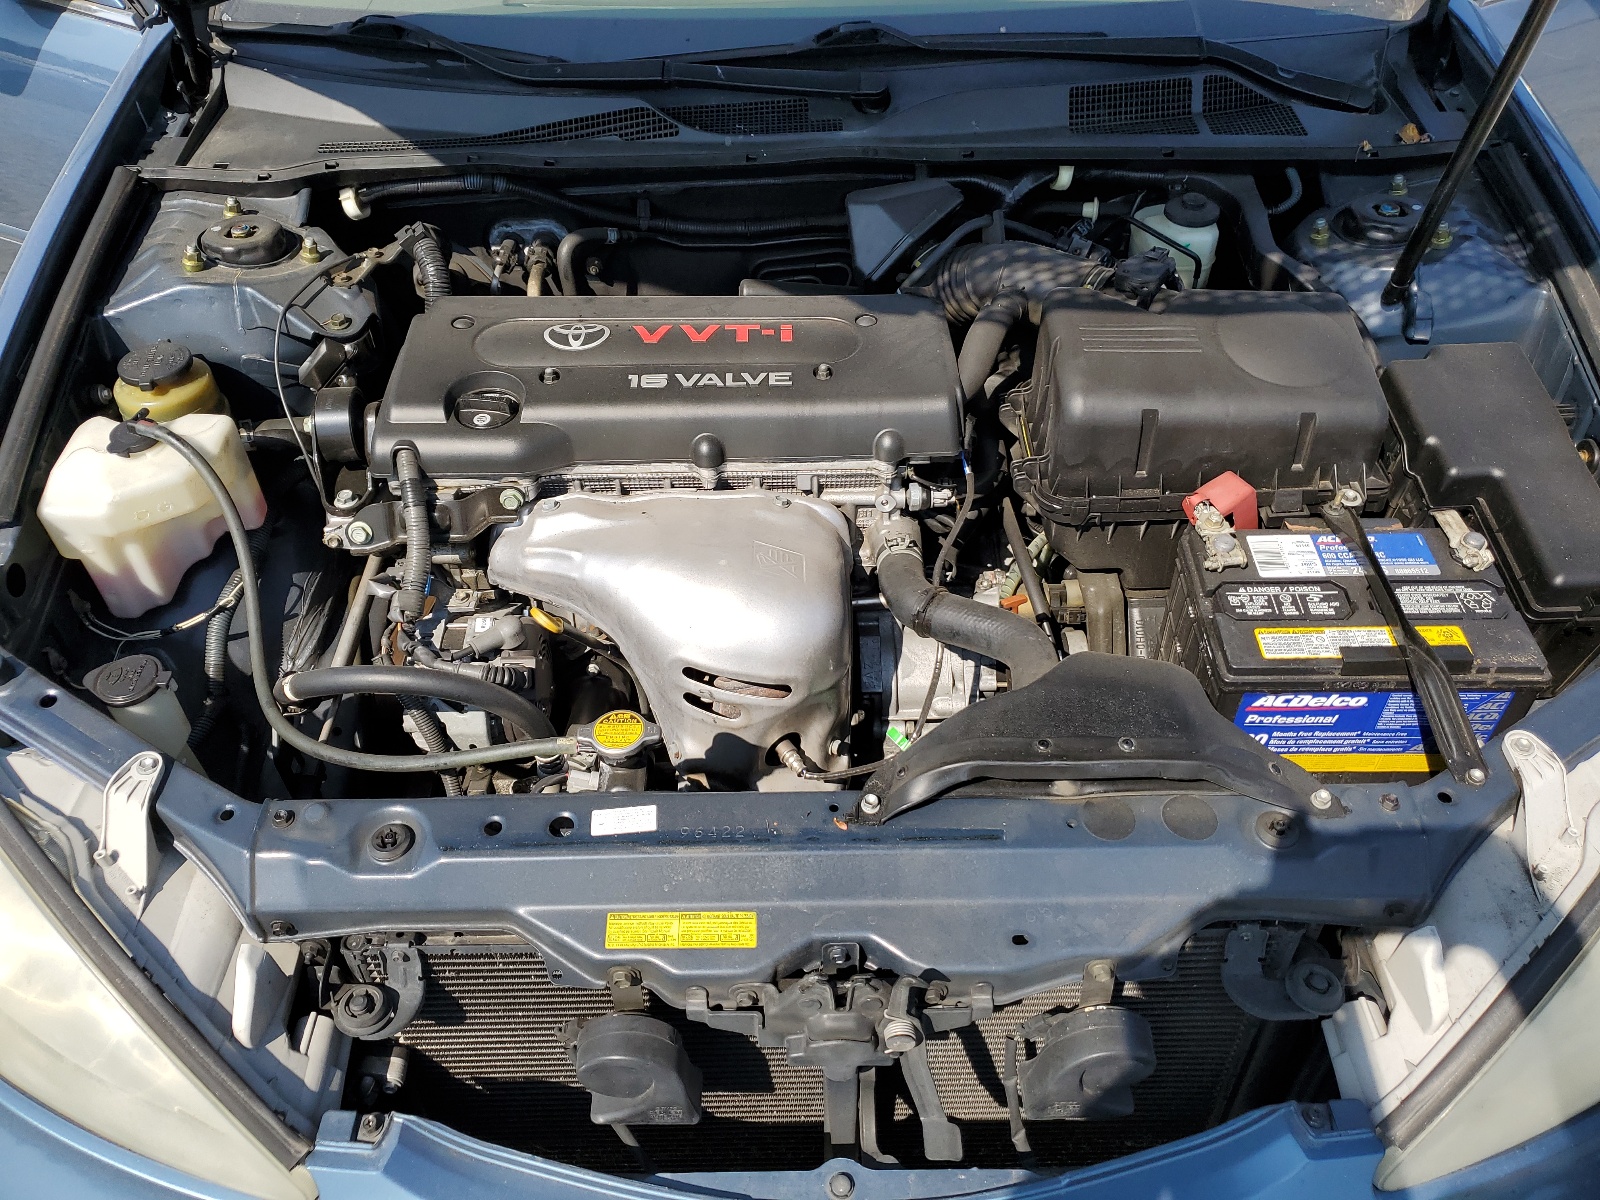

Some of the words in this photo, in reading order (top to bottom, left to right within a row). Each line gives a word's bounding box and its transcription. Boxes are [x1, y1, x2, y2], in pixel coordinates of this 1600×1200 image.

[632, 324, 793, 343] VVT-i
[628, 373, 668, 388] 16
[674, 372, 793, 388] VALVE
[1251, 694, 1368, 707] ACDelco
[1244, 714, 1339, 724] Professional
[681, 825, 745, 839] 96422
